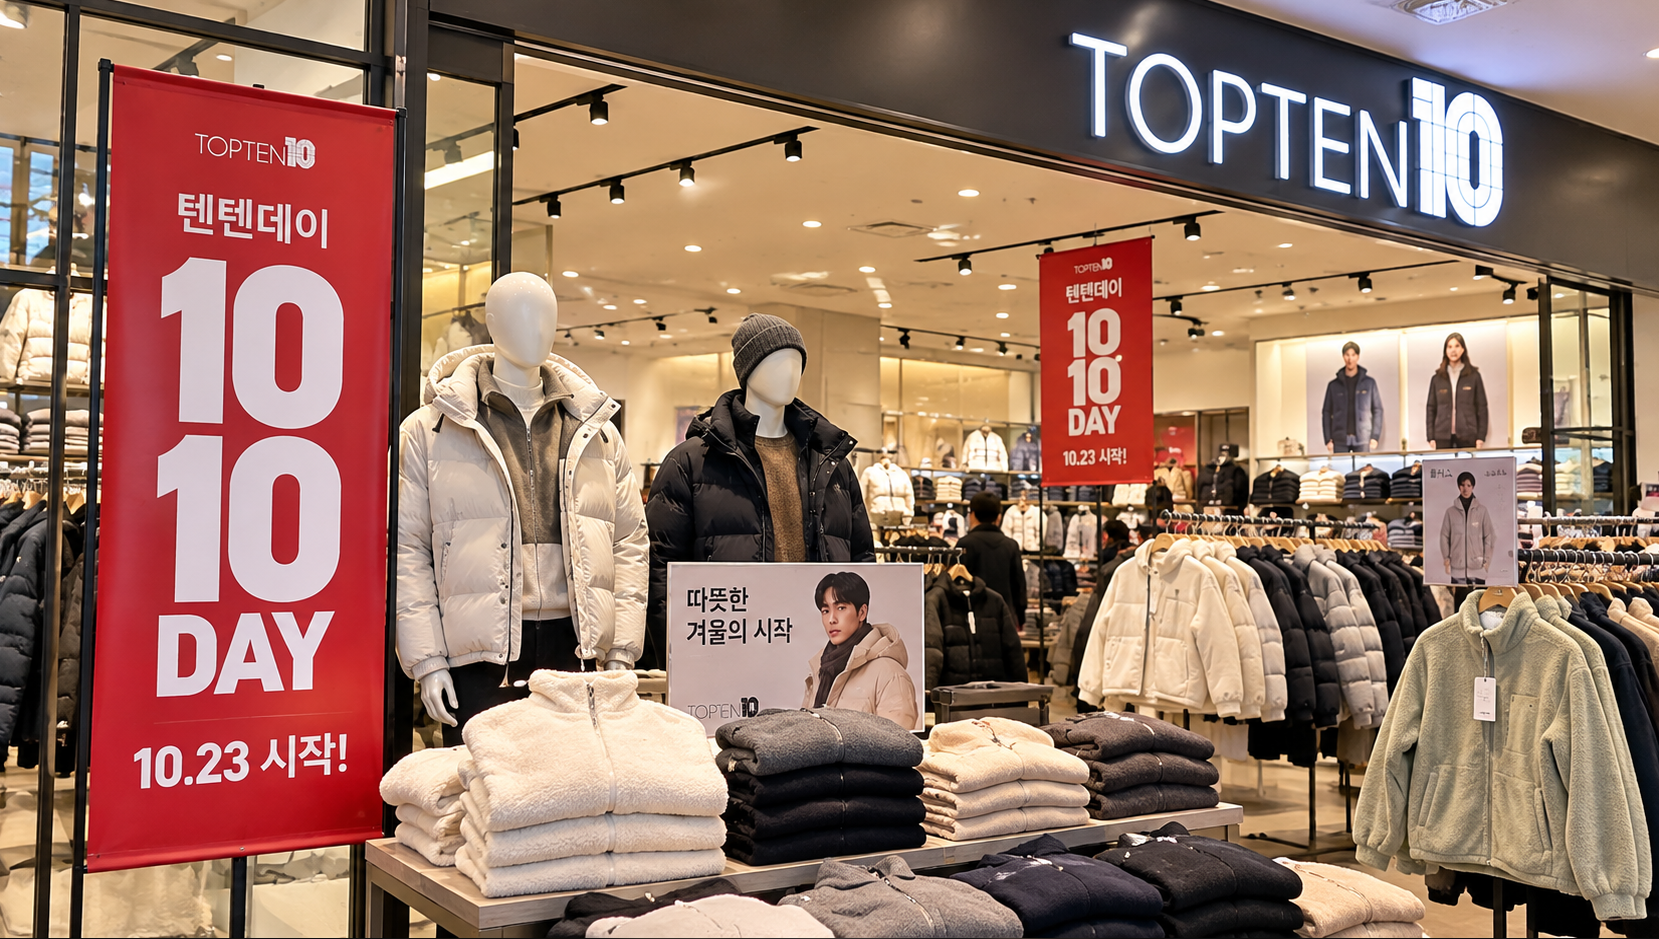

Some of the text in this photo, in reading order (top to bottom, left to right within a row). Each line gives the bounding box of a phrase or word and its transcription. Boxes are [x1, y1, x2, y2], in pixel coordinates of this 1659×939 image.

[194, 132, 316, 170] TOPTEN10
[1069, 32, 1504, 227] TOPTEN10
[177, 192, 328, 250] 텐텐데이
[1065, 277, 1122, 304] 텐텐데이
[160, 256, 345, 430] 10
[1067, 356, 1122, 407] 10
[1068, 405, 1122, 437] DAY
[1062, 446, 1128, 467] 10.23 시작!
[156, 434, 342, 603] 10
[687, 586, 749, 613] 따뜻한
[156, 610, 336, 698] DAY
[686, 617, 793, 646] 겨울의 시작
[133, 732, 348, 790] 10.23 시작!
